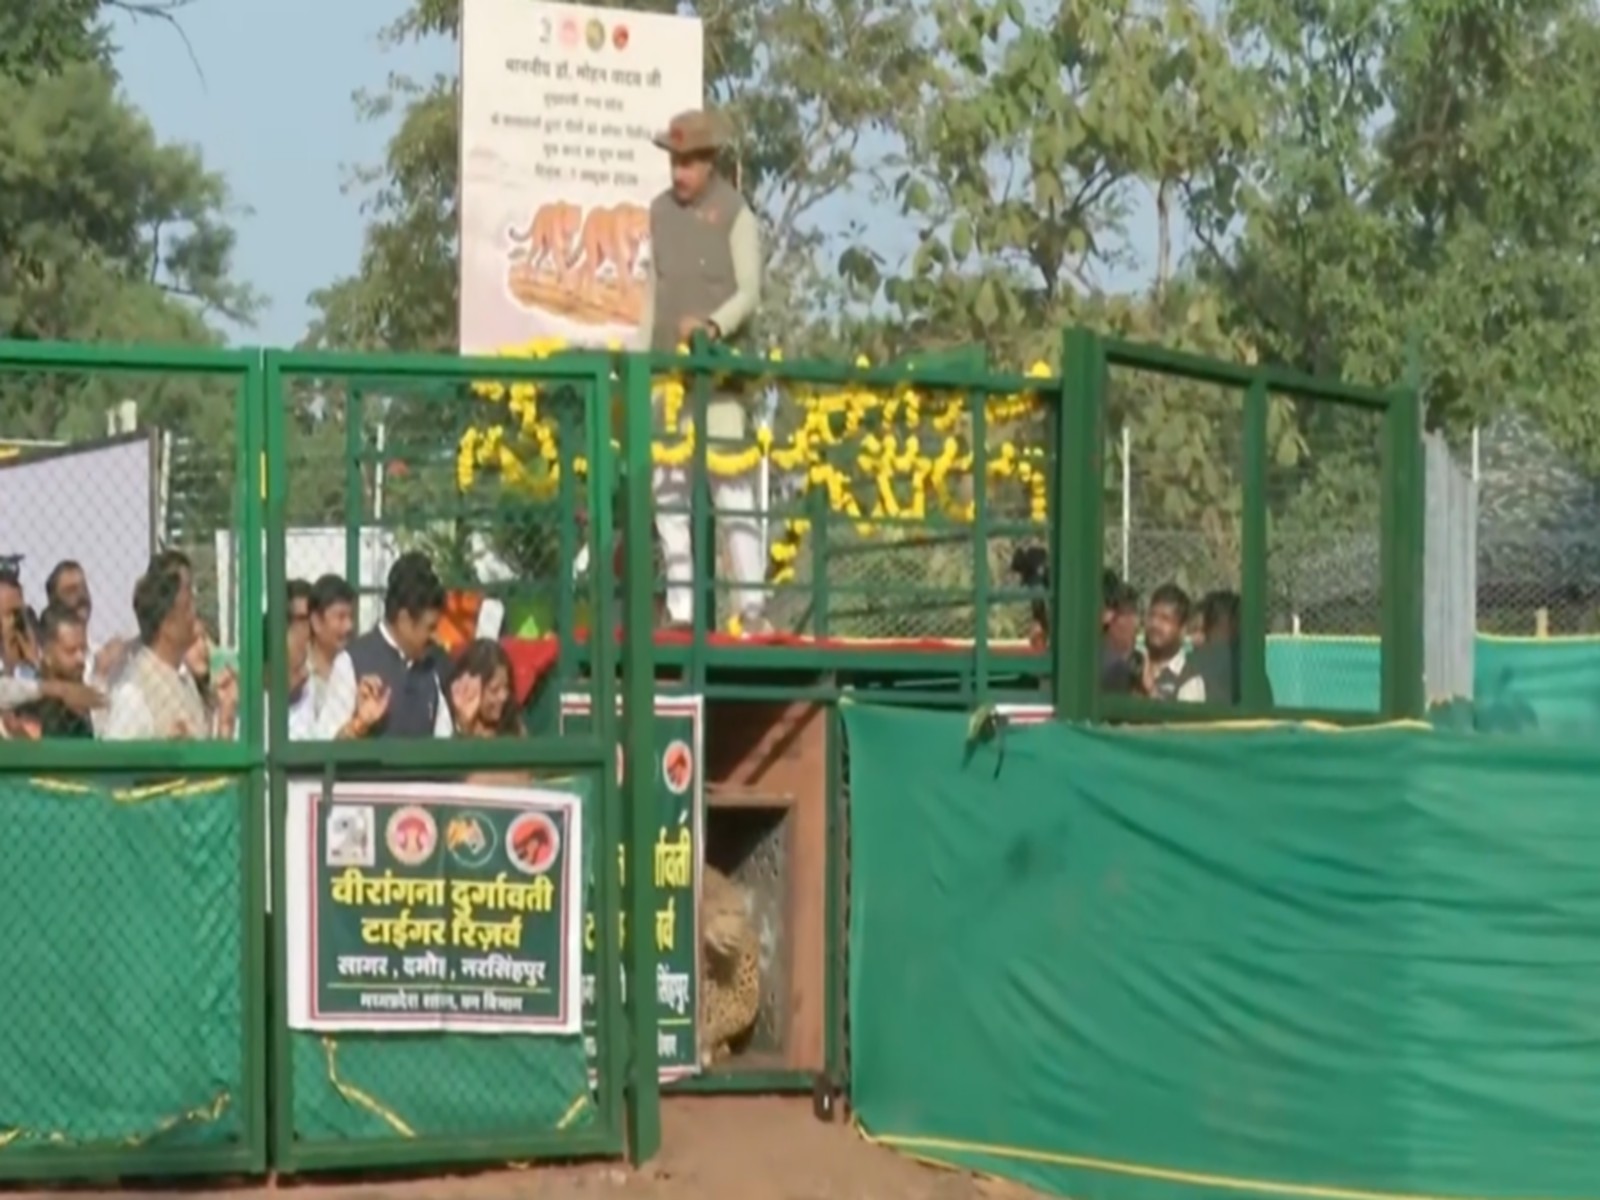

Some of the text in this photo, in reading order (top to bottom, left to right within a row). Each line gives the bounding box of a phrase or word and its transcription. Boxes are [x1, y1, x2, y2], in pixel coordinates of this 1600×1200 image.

[331, 867, 555, 914] वीरांगना दुर्गावती
[361, 909, 446, 949] टाईगर
[460, 952, 546, 988] नरसिंहपुर
